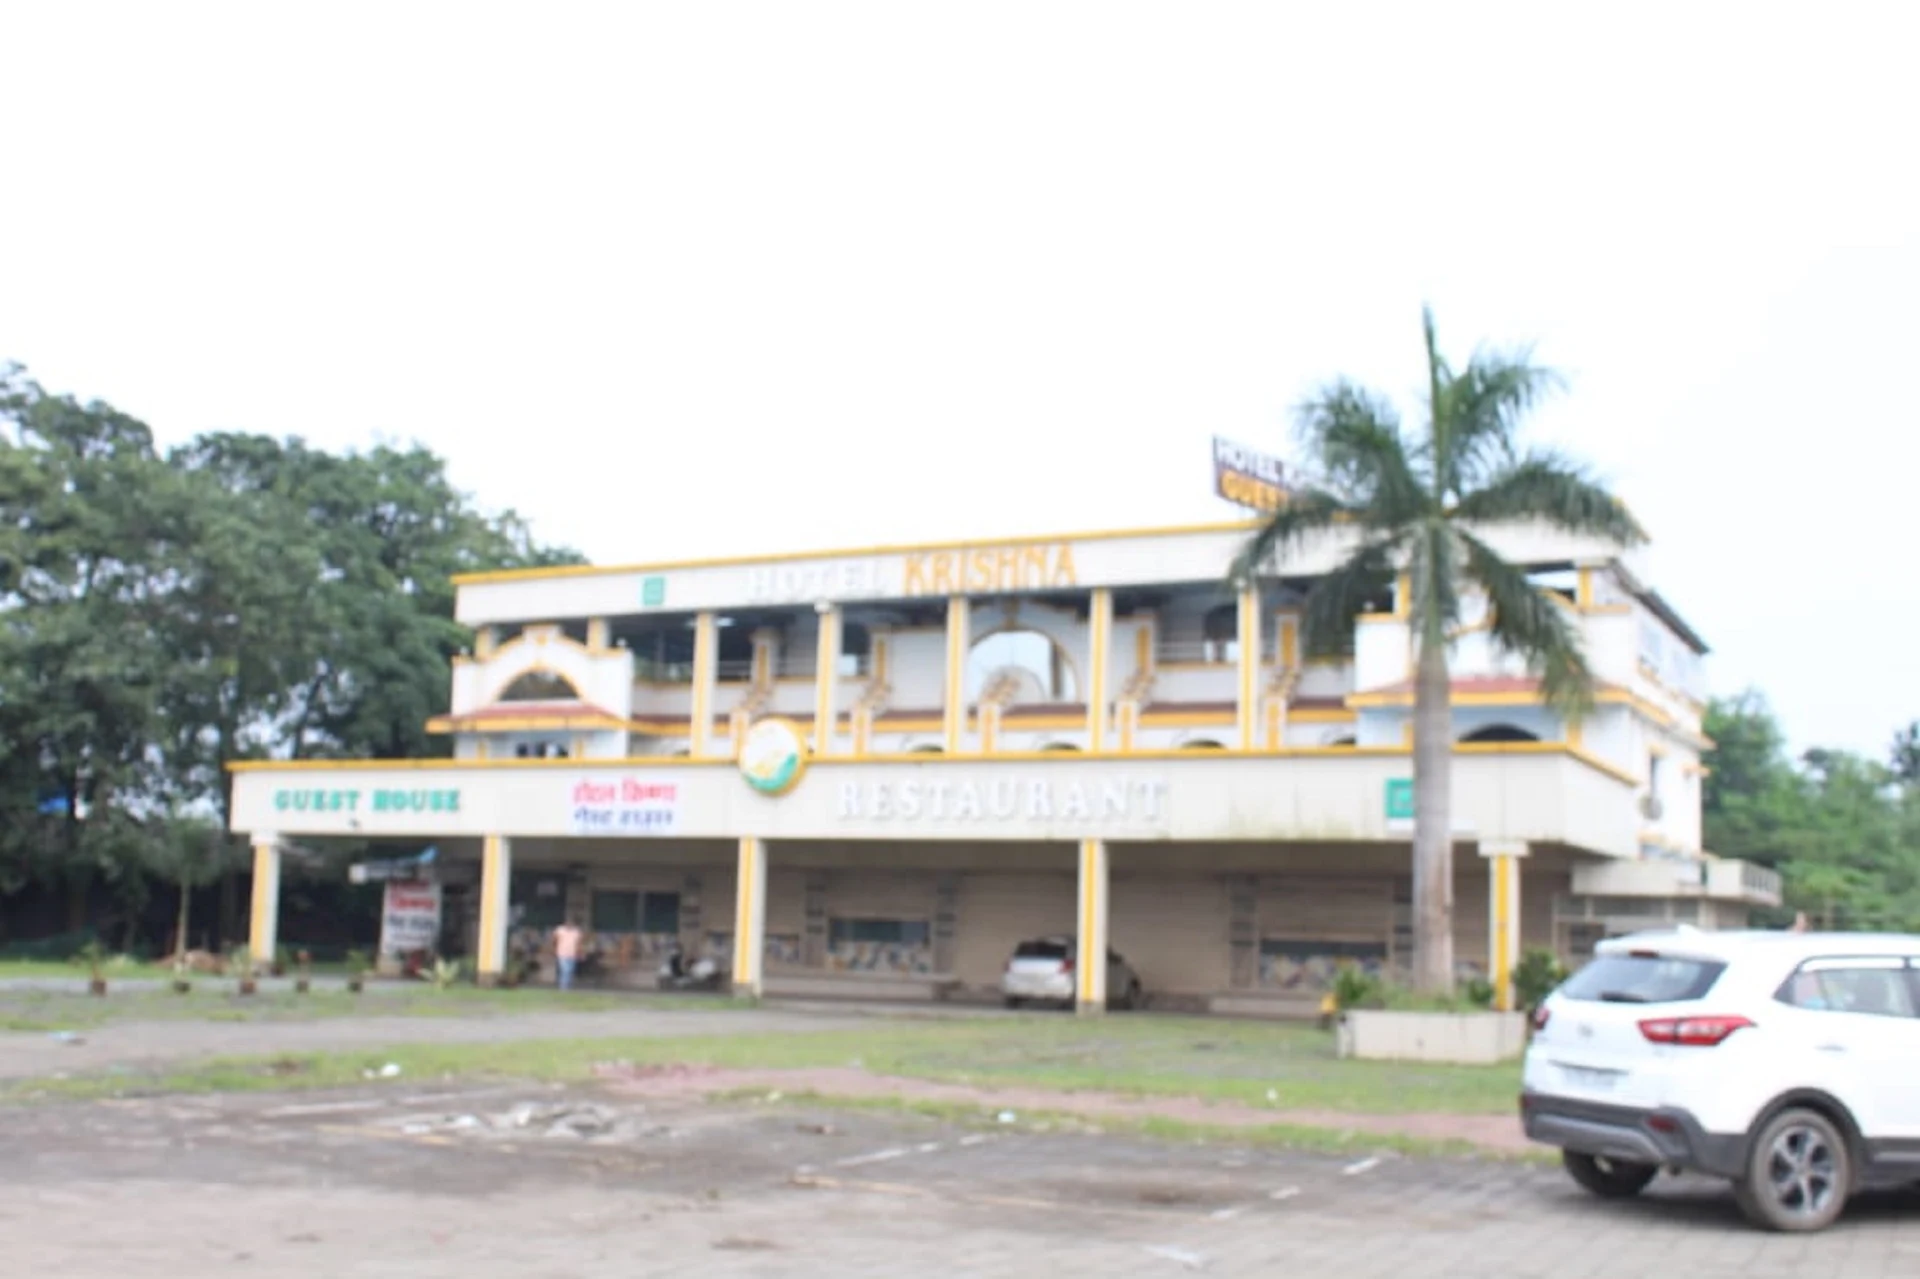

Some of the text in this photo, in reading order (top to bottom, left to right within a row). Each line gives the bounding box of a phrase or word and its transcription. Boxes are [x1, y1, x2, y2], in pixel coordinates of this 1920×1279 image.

[1215, 435, 1277, 484] HOTEL
[751, 543, 1078, 598] HOTEL KRISHNA
[275, 789, 461, 812] GUEST HOUSE
[837, 777, 1168, 822] RESTAURANT
